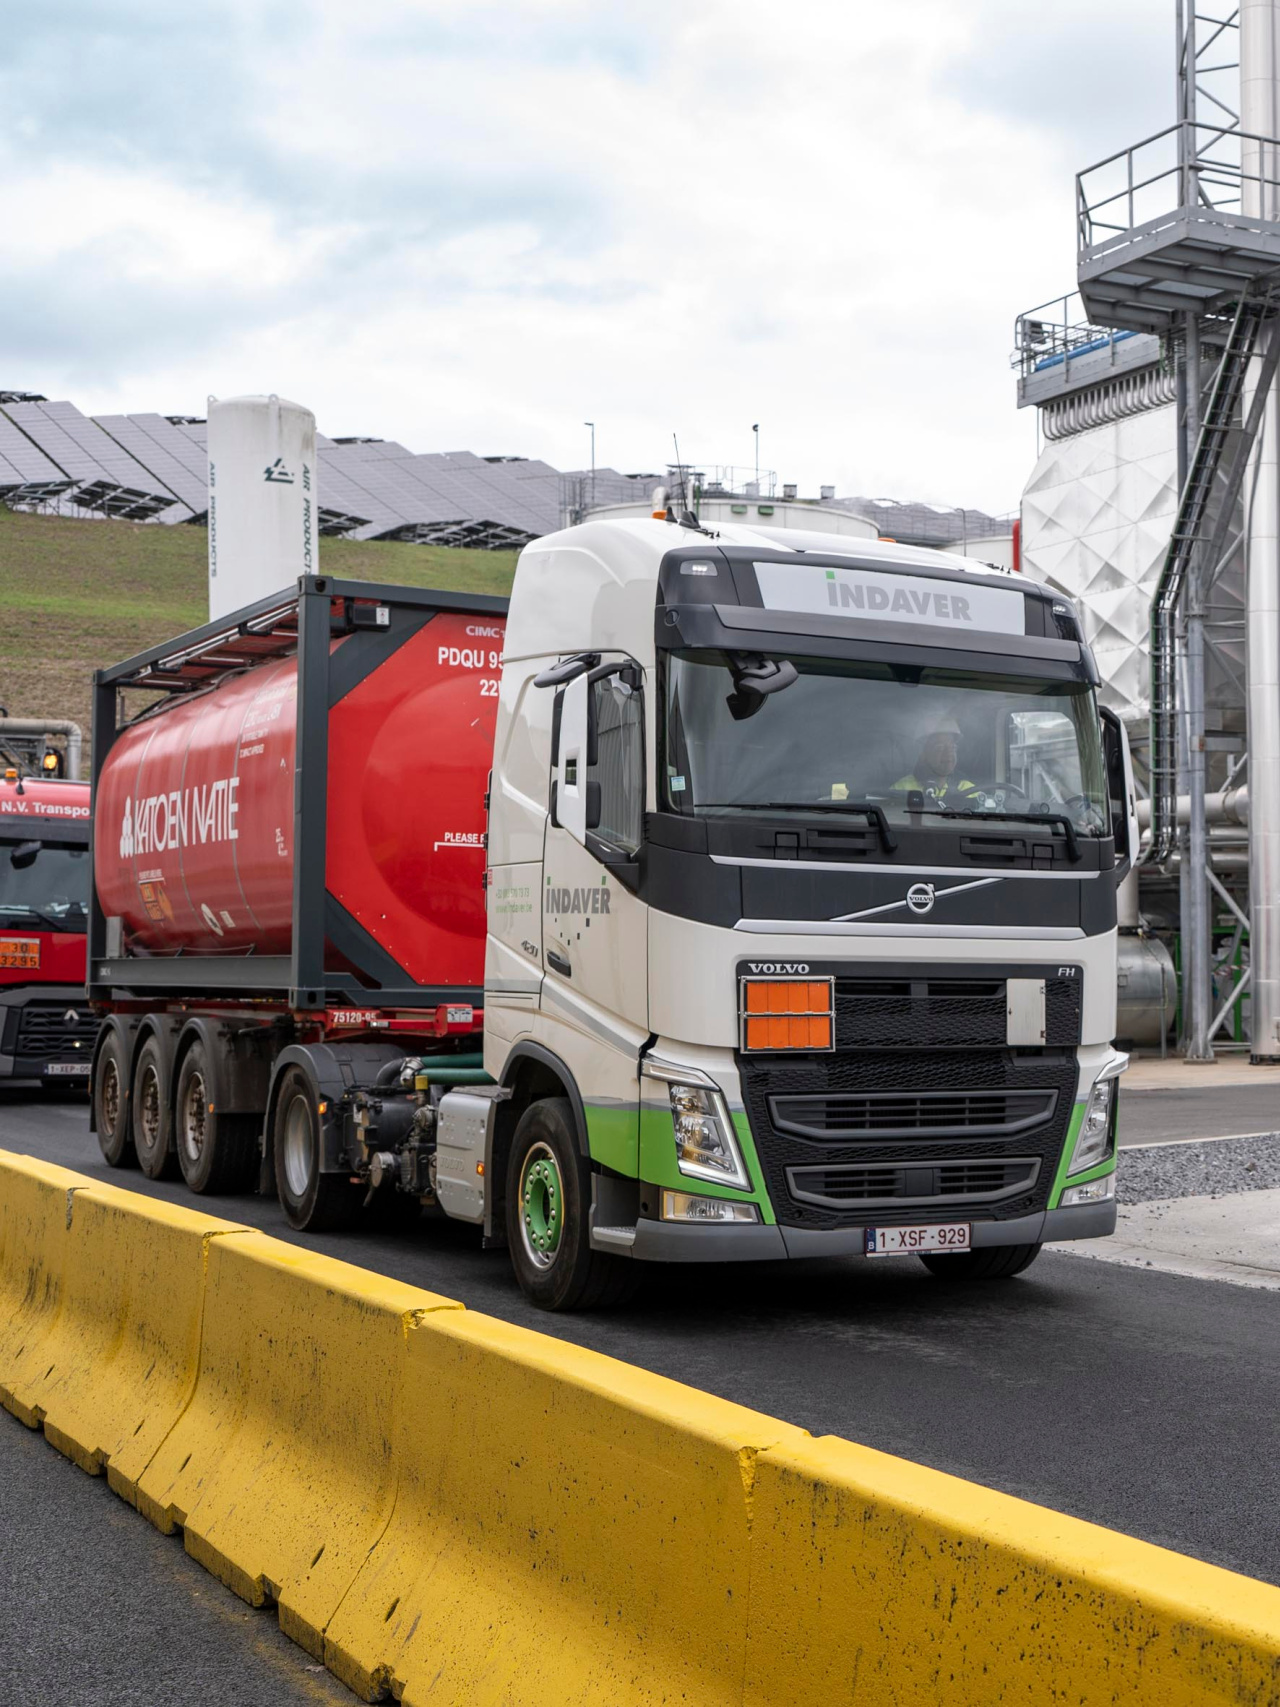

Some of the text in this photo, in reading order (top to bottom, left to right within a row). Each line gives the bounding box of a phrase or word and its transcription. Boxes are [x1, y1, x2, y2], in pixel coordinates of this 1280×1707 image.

[303, 463, 311, 491] AIR
[825, 572, 974, 622] INDAVER
[465, 625, 500, 638] CIMC
[438, 646, 485, 669] PDQU
[1, 801, 91, 818] N.V. Transpo
[134, 776, 240, 855] KATOEN NATIE
[444, 832, 478, 843] PLEASE
[546, 880, 611, 914] INDAVER
[12, 943, 28, 953] 30
[0, 956, 37, 967] 3295
[748, 963, 810, 974] VOLVO
[1057, 967, 1076, 977] FH
[879, 1227, 966, 1249] 1-XSF-929
